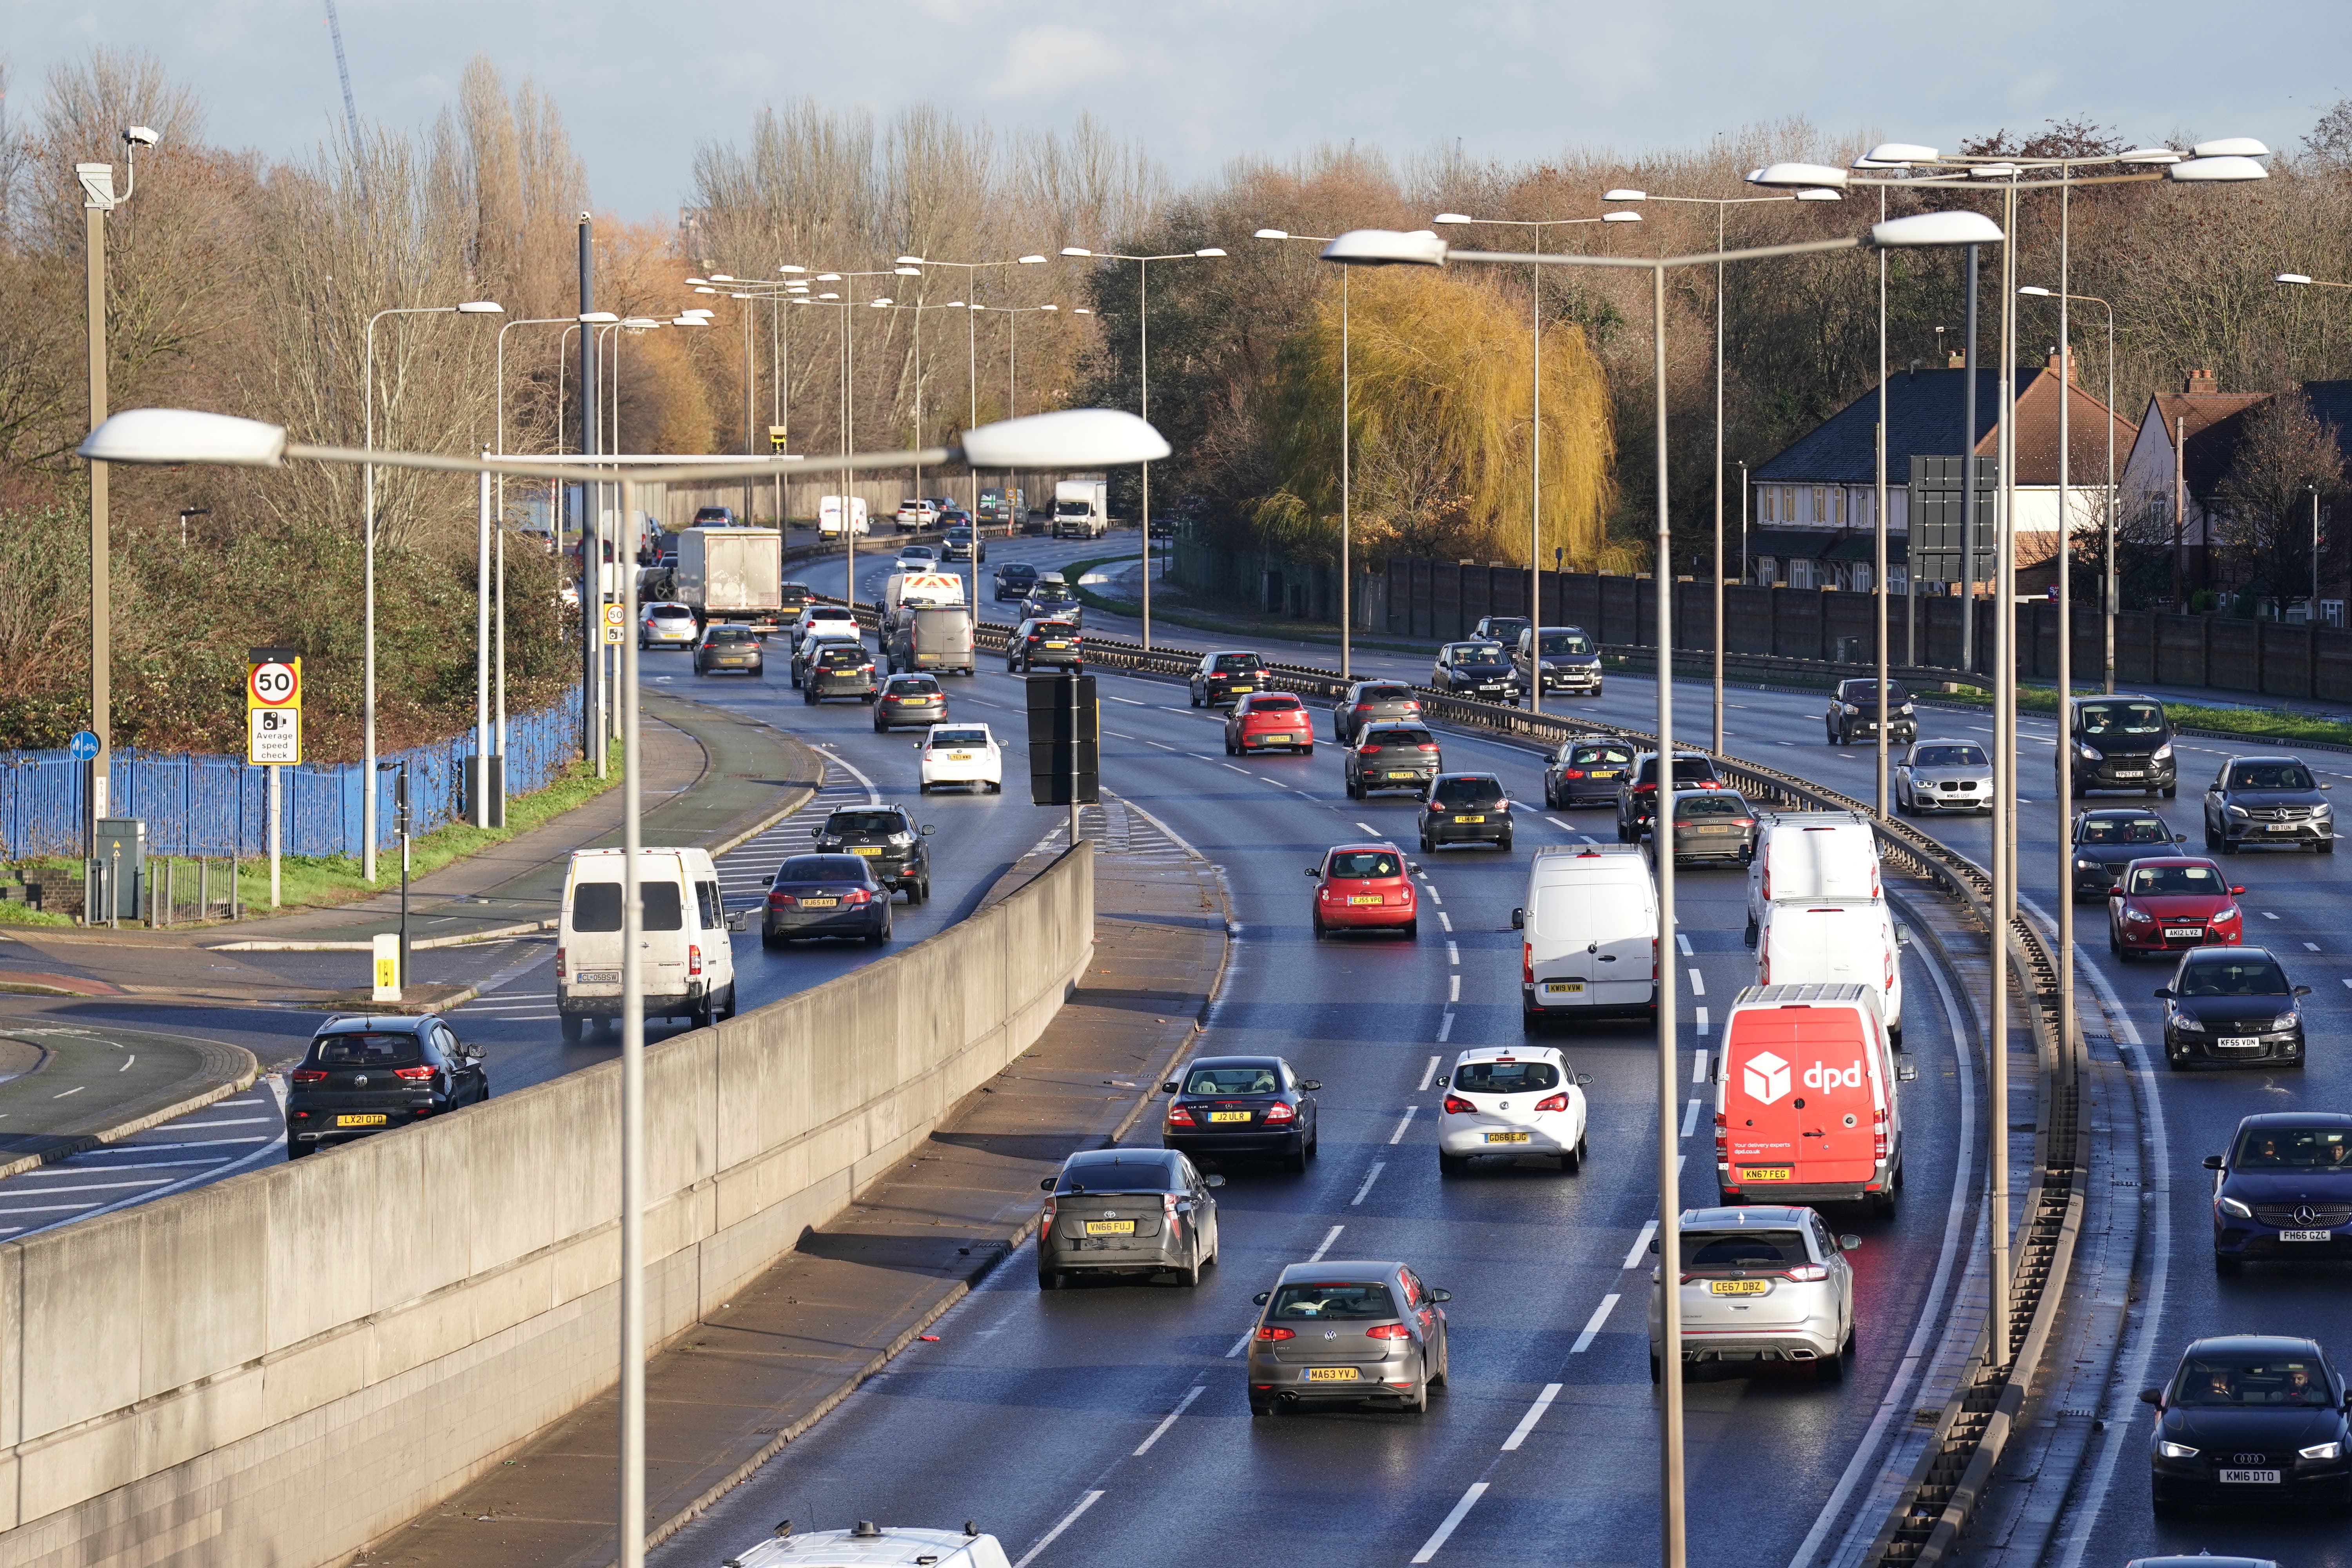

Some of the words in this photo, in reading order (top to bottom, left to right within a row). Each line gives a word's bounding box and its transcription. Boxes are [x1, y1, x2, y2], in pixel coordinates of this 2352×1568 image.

[259, 673, 290, 691] 50
[1803, 1060, 1861, 1094] dpd
[345, 1116, 364, 1124] LX21
[1091, 1223, 1112, 1231] VN66
[1716, 1283, 1740, 1291] CE67
[1743, 1282, 1760, 1290] DBZ
[1311, 1369, 1336, 1379] MA63
[1338, 1368, 1356, 1378] YVJ
[2226, 1471, 2250, 1481] KM16
[2253, 1471, 2274, 1481] DTO
